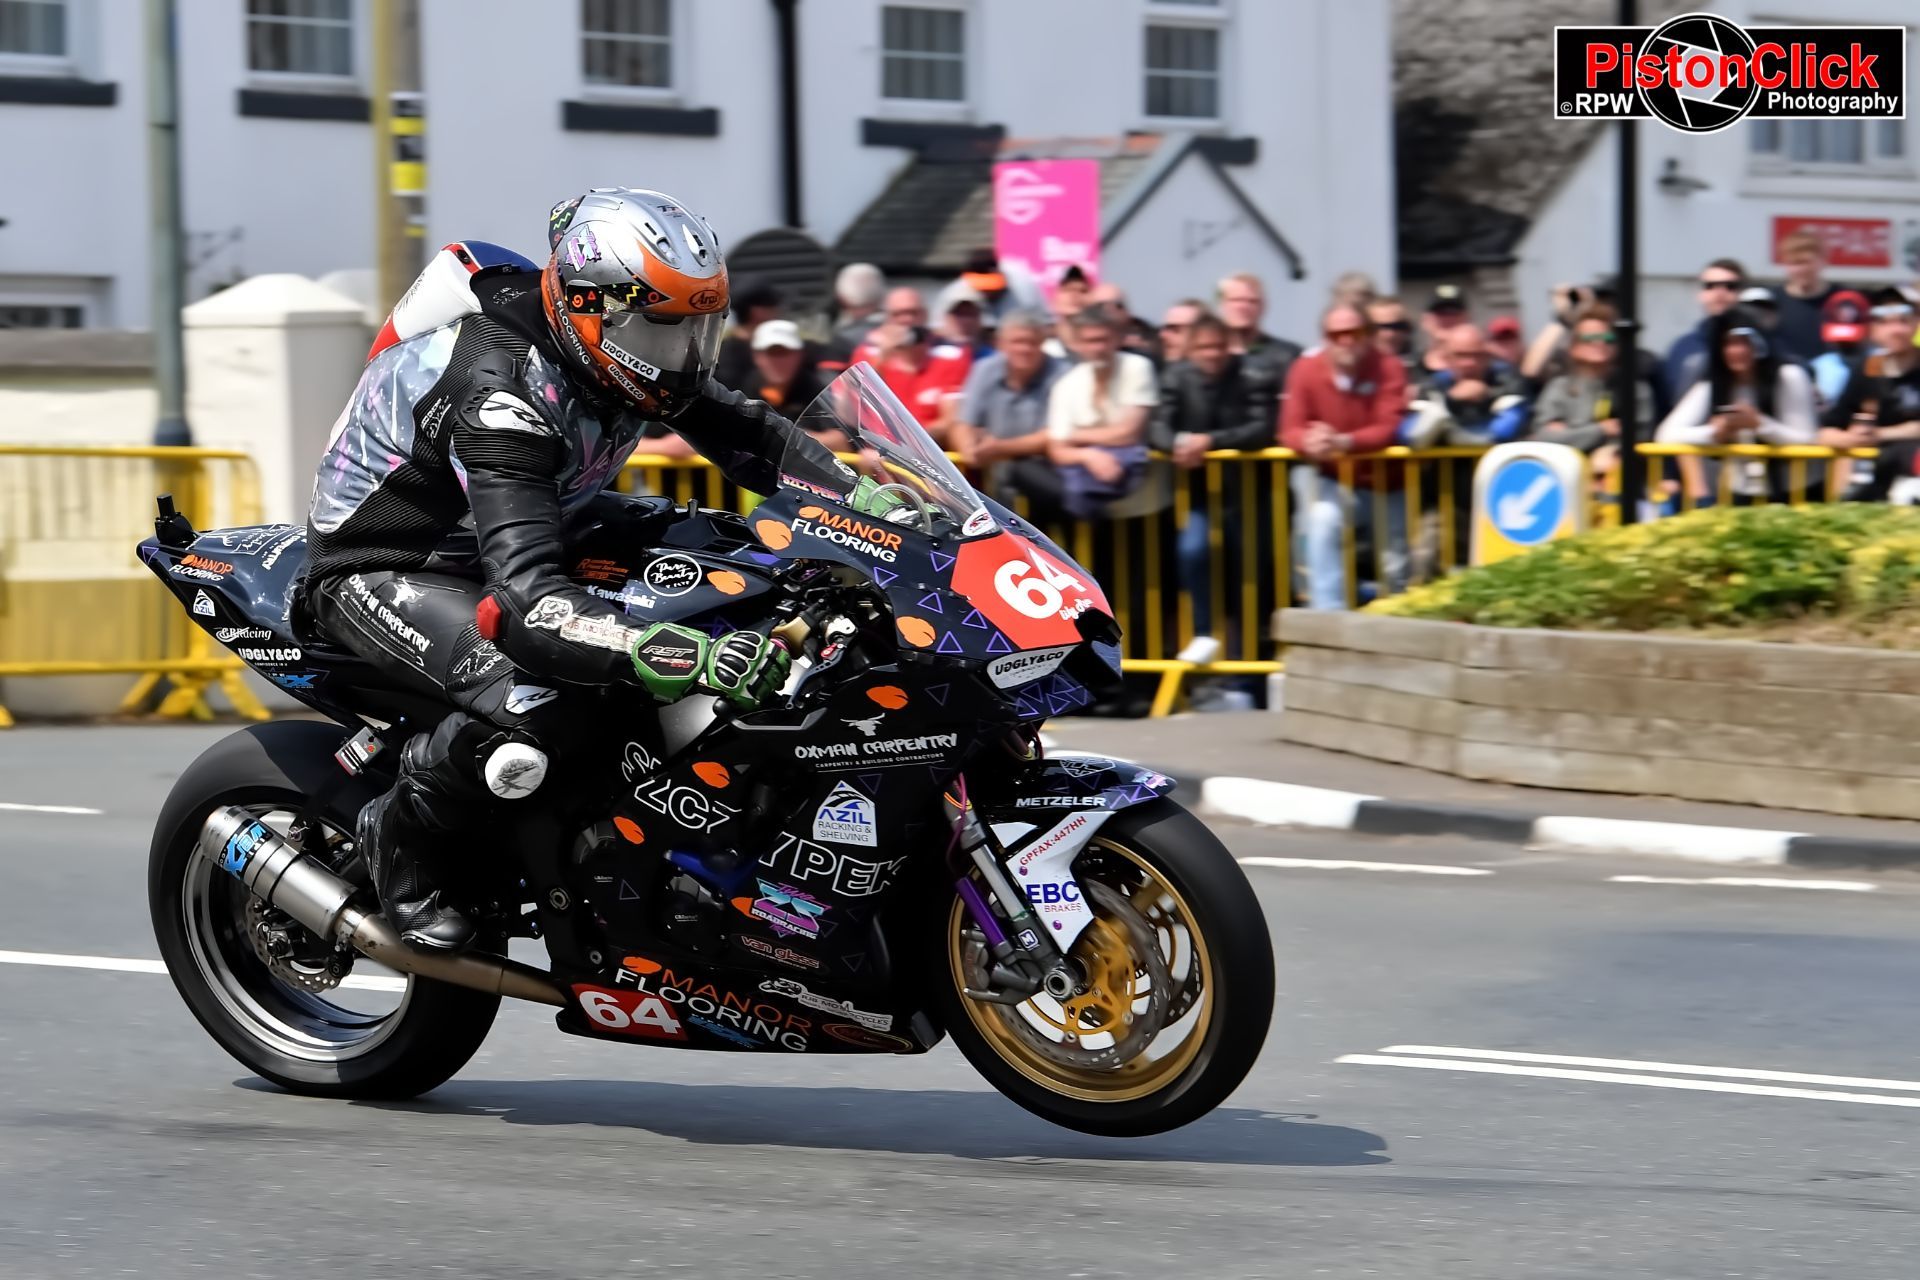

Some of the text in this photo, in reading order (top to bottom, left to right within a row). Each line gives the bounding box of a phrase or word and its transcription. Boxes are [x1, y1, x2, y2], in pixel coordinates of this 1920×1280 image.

[556, 301, 591, 365] FLOORING
[791, 518, 897, 563] FLOORING
[818, 510, 902, 551] MANOR
[169, 564, 224, 582] FLOORING
[994, 547, 1087, 619] 64
[641, 645, 697, 657] RST
[794, 733, 958, 759] OXMAN CARPENTRY
[815, 761, 853, 769] CARPENTRY
[861, 757, 894, 766] BUILDING
[895, 752, 944, 762] CONTRACTORS
[1015, 796, 1107, 808] METZELER
[818, 808, 872, 825] AZIL
[818, 820, 862, 833] RACKING
[820, 830, 869, 842] SHELVING
[1020, 816, 1087, 867] GPFAX:447HH
[1026, 880, 1080, 904] EBC
[1044, 902, 1082, 913] BRAKES
[751, 907, 819, 940] ROADRACING
[741, 935, 773, 953] van
[579, 990, 682, 1034] 64
[615, 968, 808, 1051] FLOORING
[662, 969, 813, 1037] MANOR
